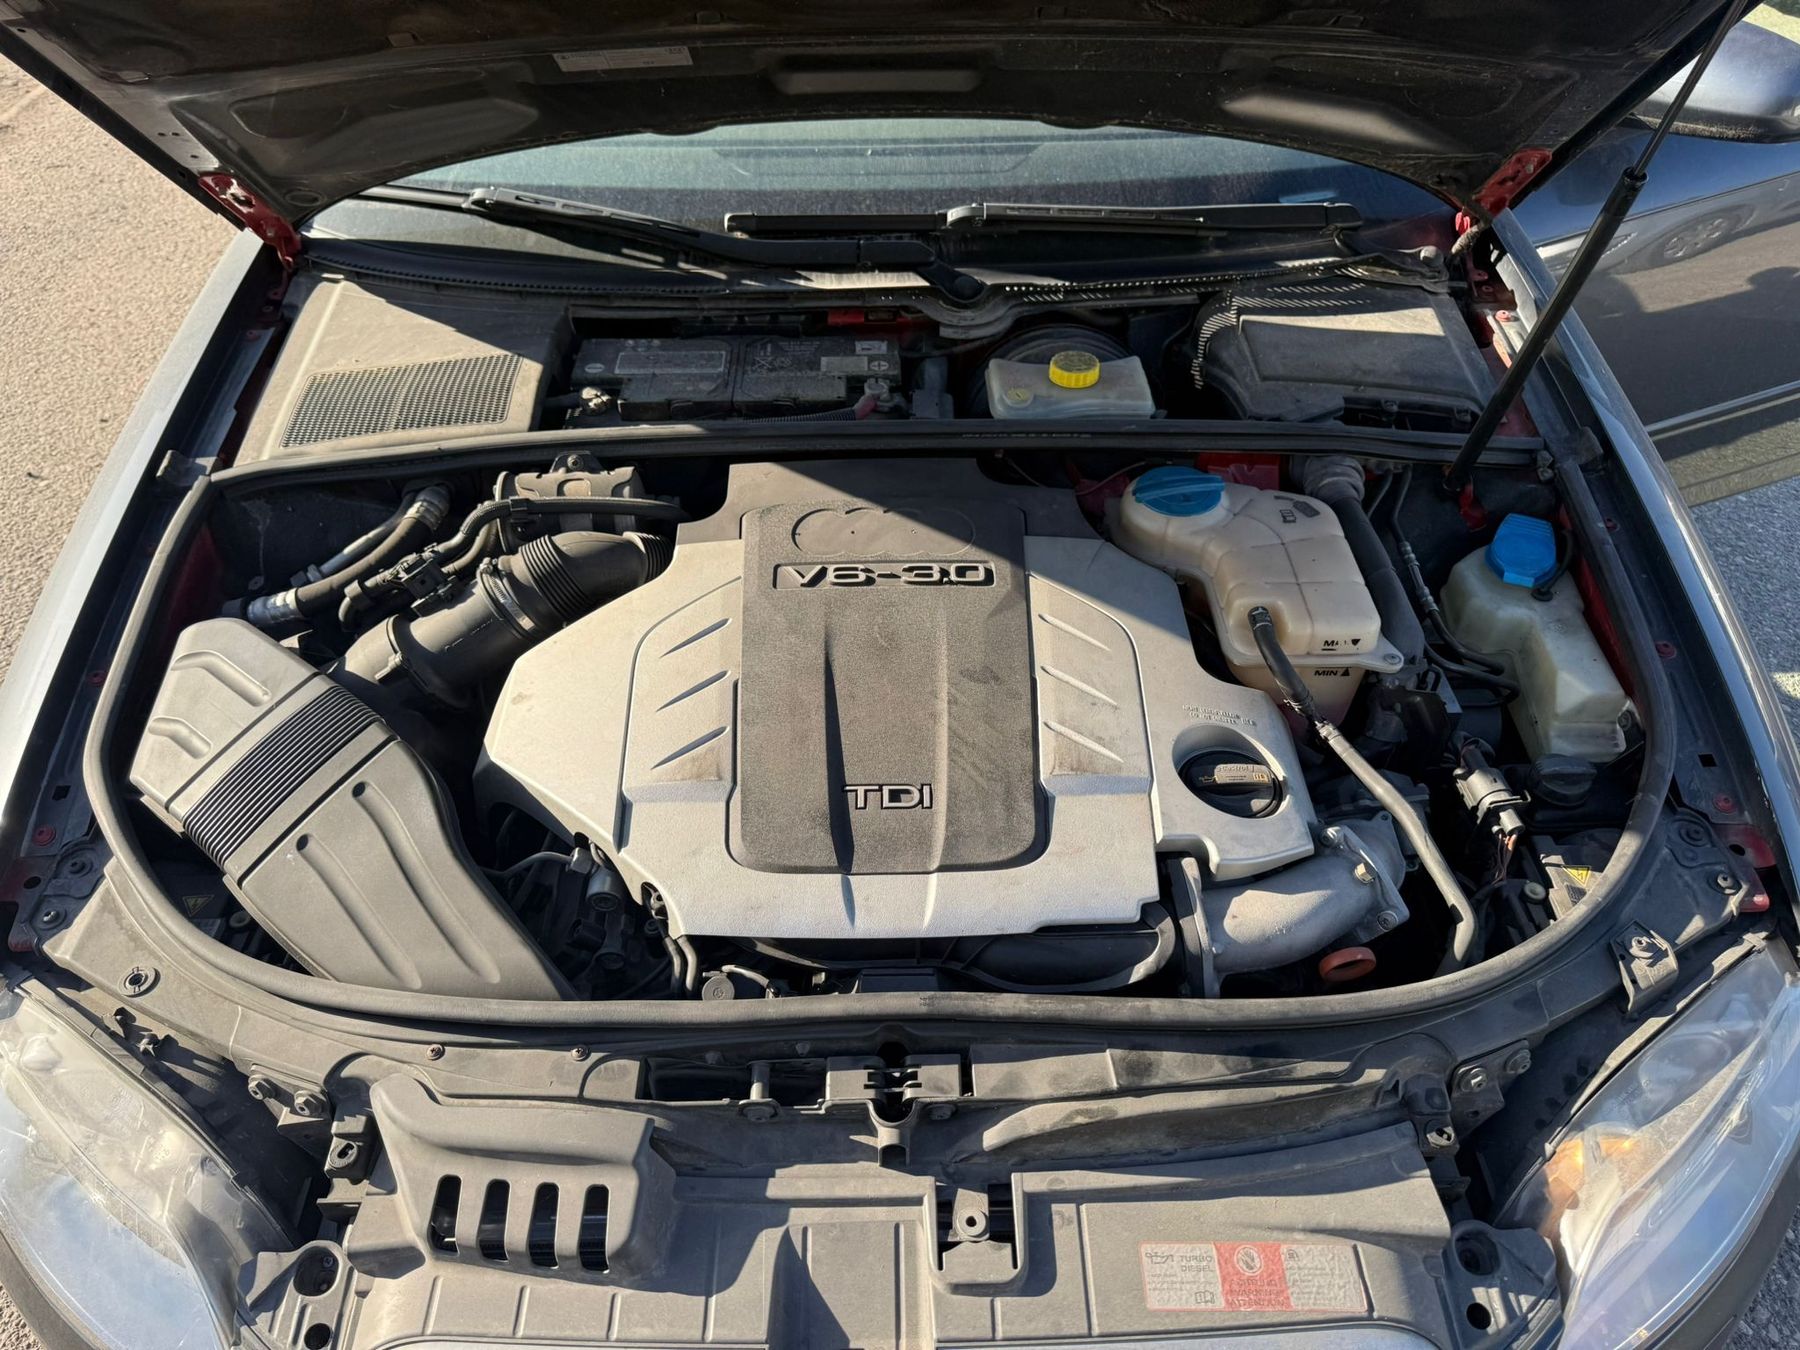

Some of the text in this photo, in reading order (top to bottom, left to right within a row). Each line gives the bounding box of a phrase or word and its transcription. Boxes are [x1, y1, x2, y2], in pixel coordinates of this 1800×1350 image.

[777, 563, 991, 587] V6-3.0
[1314, 669, 1338, 677] MIN
[843, 784, 934, 809] TDI
[1180, 1255, 1213, 1263] TURBO
[1180, 1264, 1215, 1273] DIESEL
